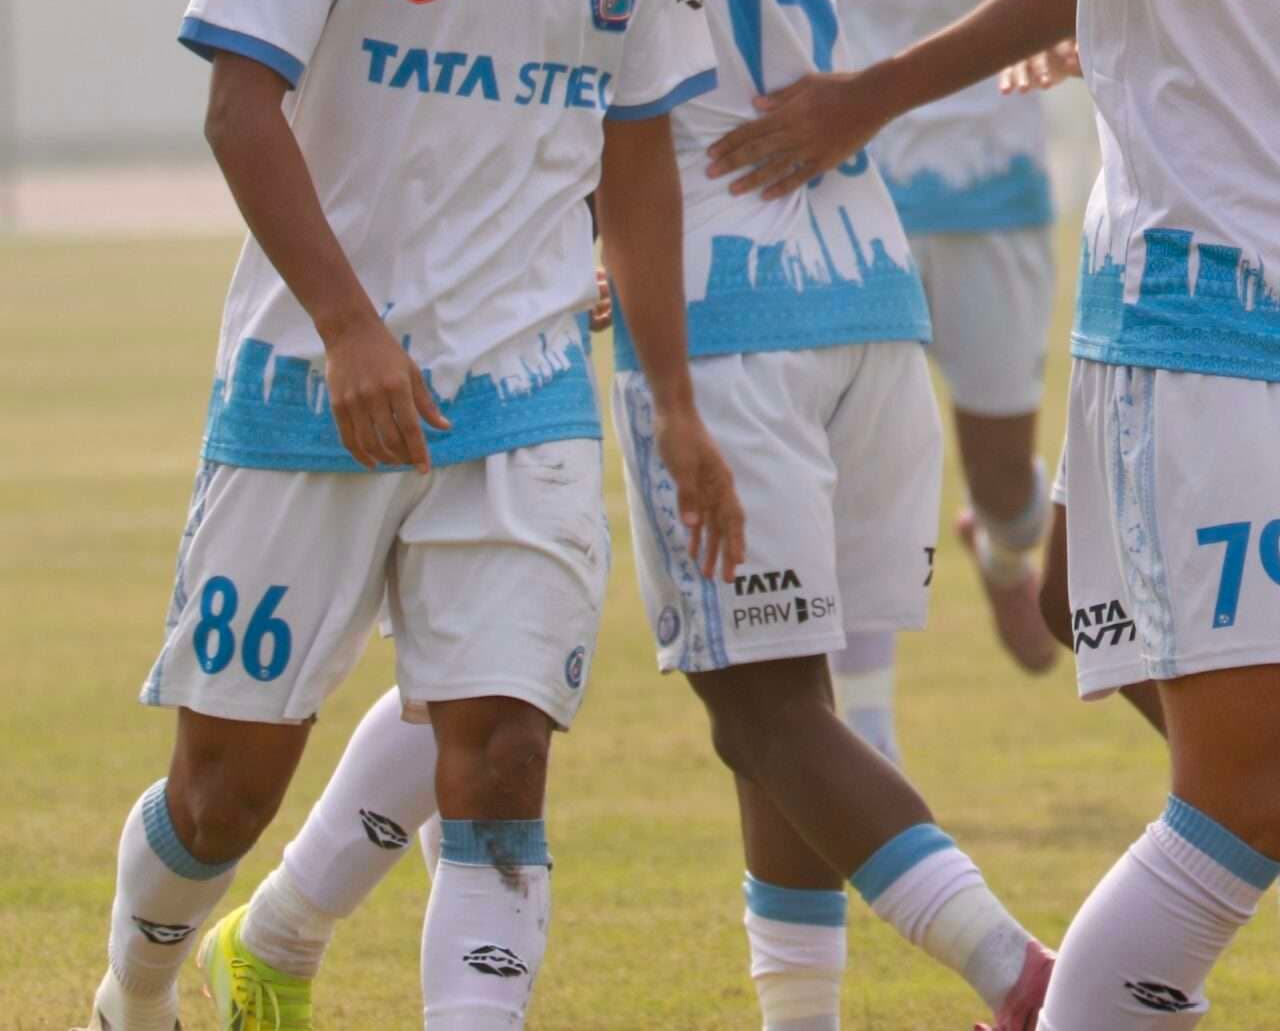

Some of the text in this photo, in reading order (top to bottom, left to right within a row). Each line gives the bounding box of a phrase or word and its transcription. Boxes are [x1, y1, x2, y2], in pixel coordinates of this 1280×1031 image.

[361, 38, 501, 101] TATA
[734, 569, 802, 596] TATA
[193, 575, 293, 682] 86
